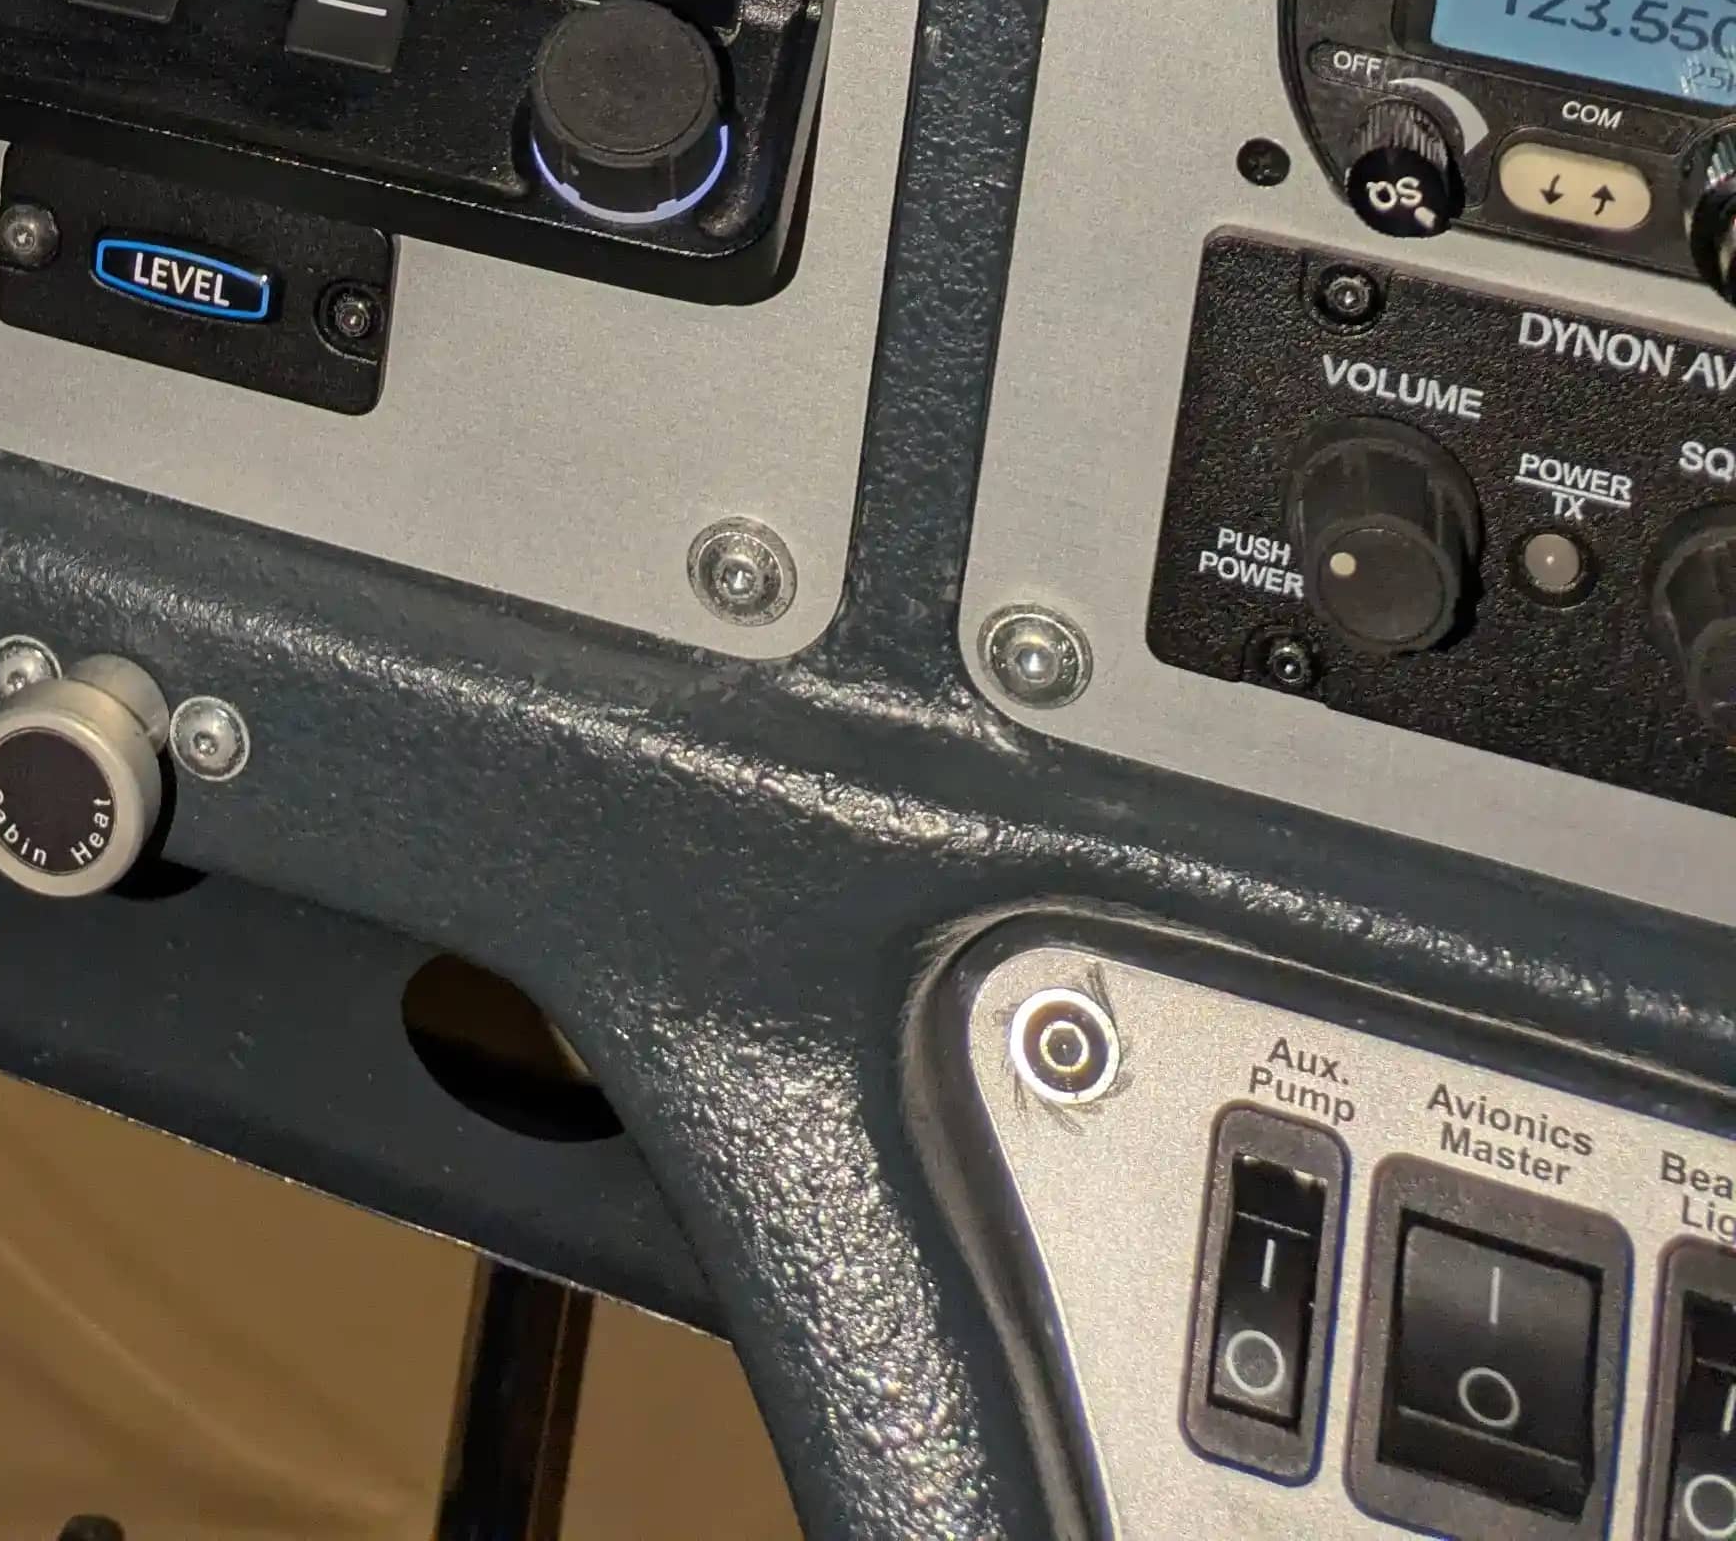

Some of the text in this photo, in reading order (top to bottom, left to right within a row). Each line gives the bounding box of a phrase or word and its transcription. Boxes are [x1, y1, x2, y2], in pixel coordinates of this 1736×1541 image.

[1333, 50, 1382, 77] OFF
[1561, 100, 1623, 131] COM
[132, 252, 230, 307] LEVEL
[1518, 312, 1675, 376] DYNON
[1323, 354, 1485, 418] VOLUME
[1519, 453, 1632, 498] POWER
[1551, 492, 1585, 520] TX
[1217, 527, 1291, 566] PUSH
[1198, 551, 1304, 599] POWER
[71, 797, 112, 866] Heat
[1267, 1037, 1350, 1084] Aux.
[1248, 1066, 1356, 1124] Pump
[1427, 1083, 1594, 1156] Avionics
[1439, 1122, 1570, 1185] Master
